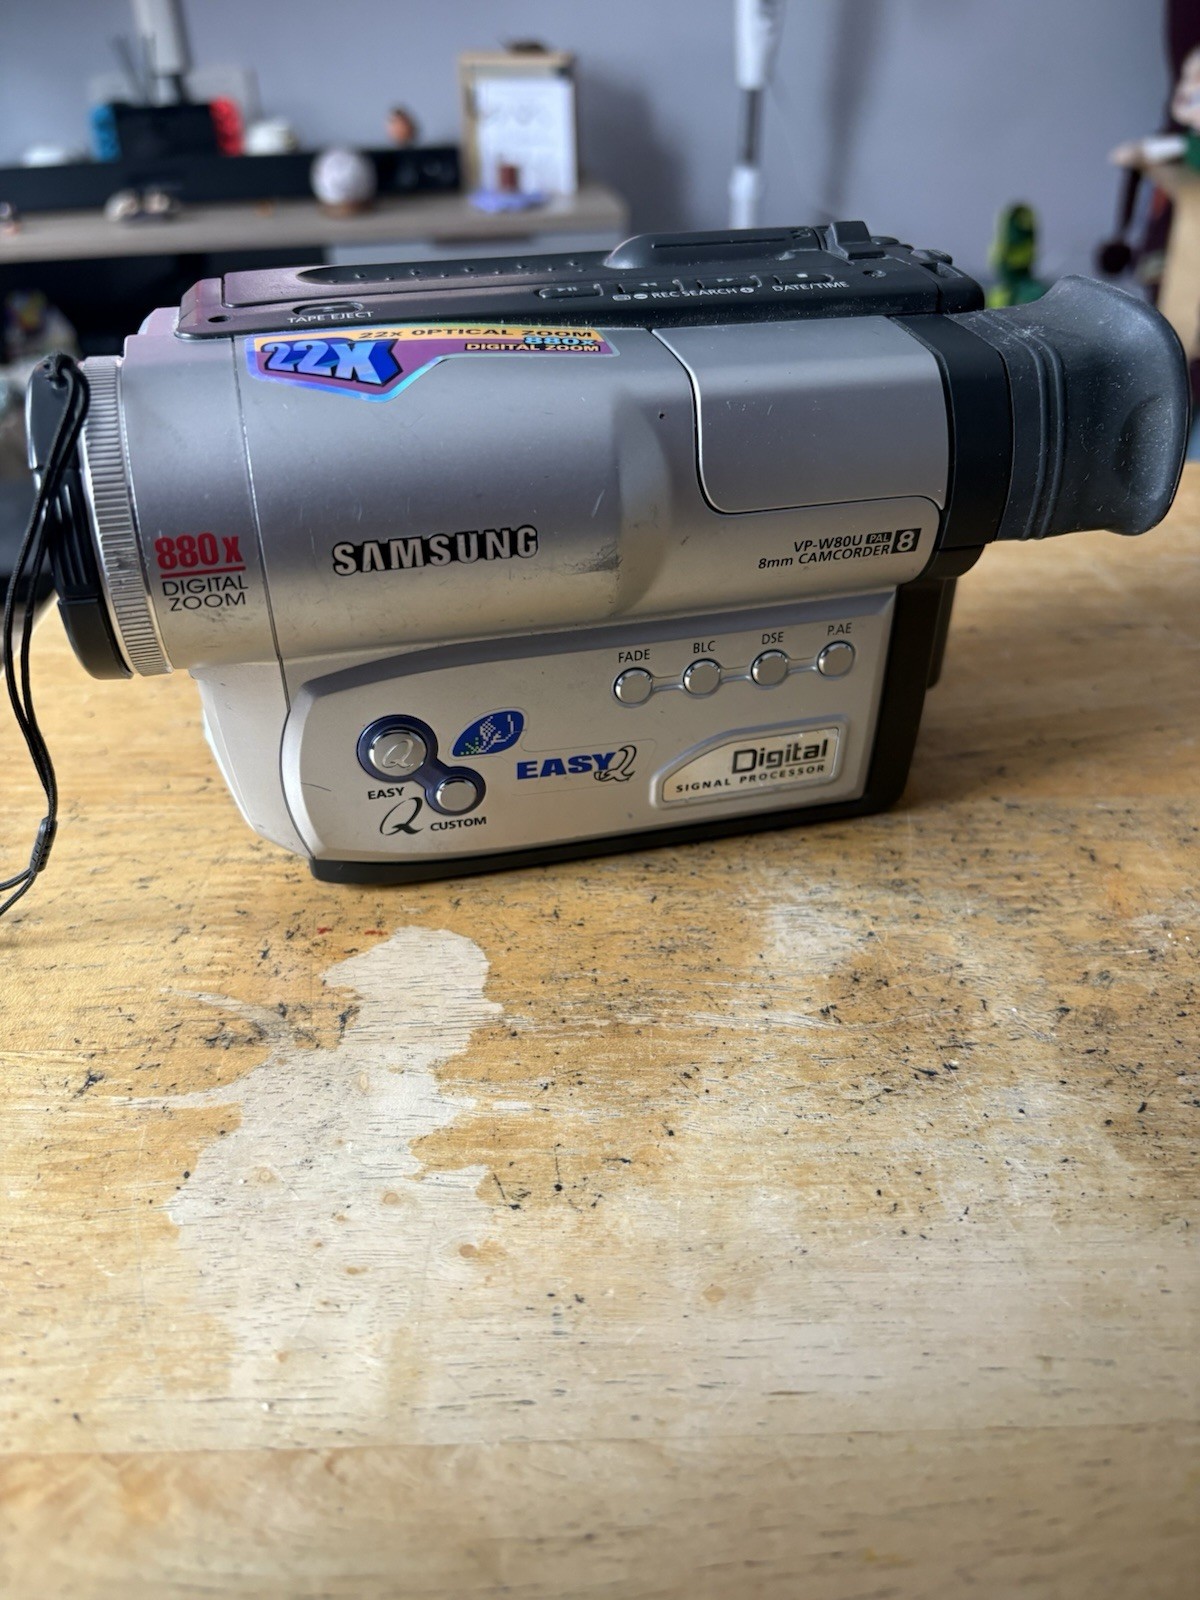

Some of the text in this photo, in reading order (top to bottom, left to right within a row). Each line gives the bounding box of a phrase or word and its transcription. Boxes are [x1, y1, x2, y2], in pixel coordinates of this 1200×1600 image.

[650, 286, 739, 299] REC SEARCH
[771, 280, 850, 292] DATE/TIME
[286, 311, 374, 325] TAPE EJECT
[411, 328, 511, 337] OPTICAL
[521, 329, 593, 338] ZOOM
[522, 336, 598, 346] 880x
[465, 343, 601, 353] DIGITAL ZOOM
[260, 338, 386, 385] 22X
[793, 533, 891, 553] VP-W80U PAL
[895, 529, 916, 552] 8
[332, 524, 539, 576] SAMSUNG
[757, 544, 892, 569] 8mm CAMCORDER
[161, 574, 249, 597] DIGITAL
[169, 591, 248, 612] ZOOM
[826, 622, 853, 636] P.AE
[761, 631, 785, 645] DSE
[692, 640, 717, 653] BLC
[617, 648, 651, 664] FADE
[731, 738, 829, 775] Digital
[675, 764, 826, 793] SIGNAL PROCESSOR
[367, 786, 405, 801] EASY
[379, 796, 425, 836] Q
[429, 815, 488, 832] CUSTOM
